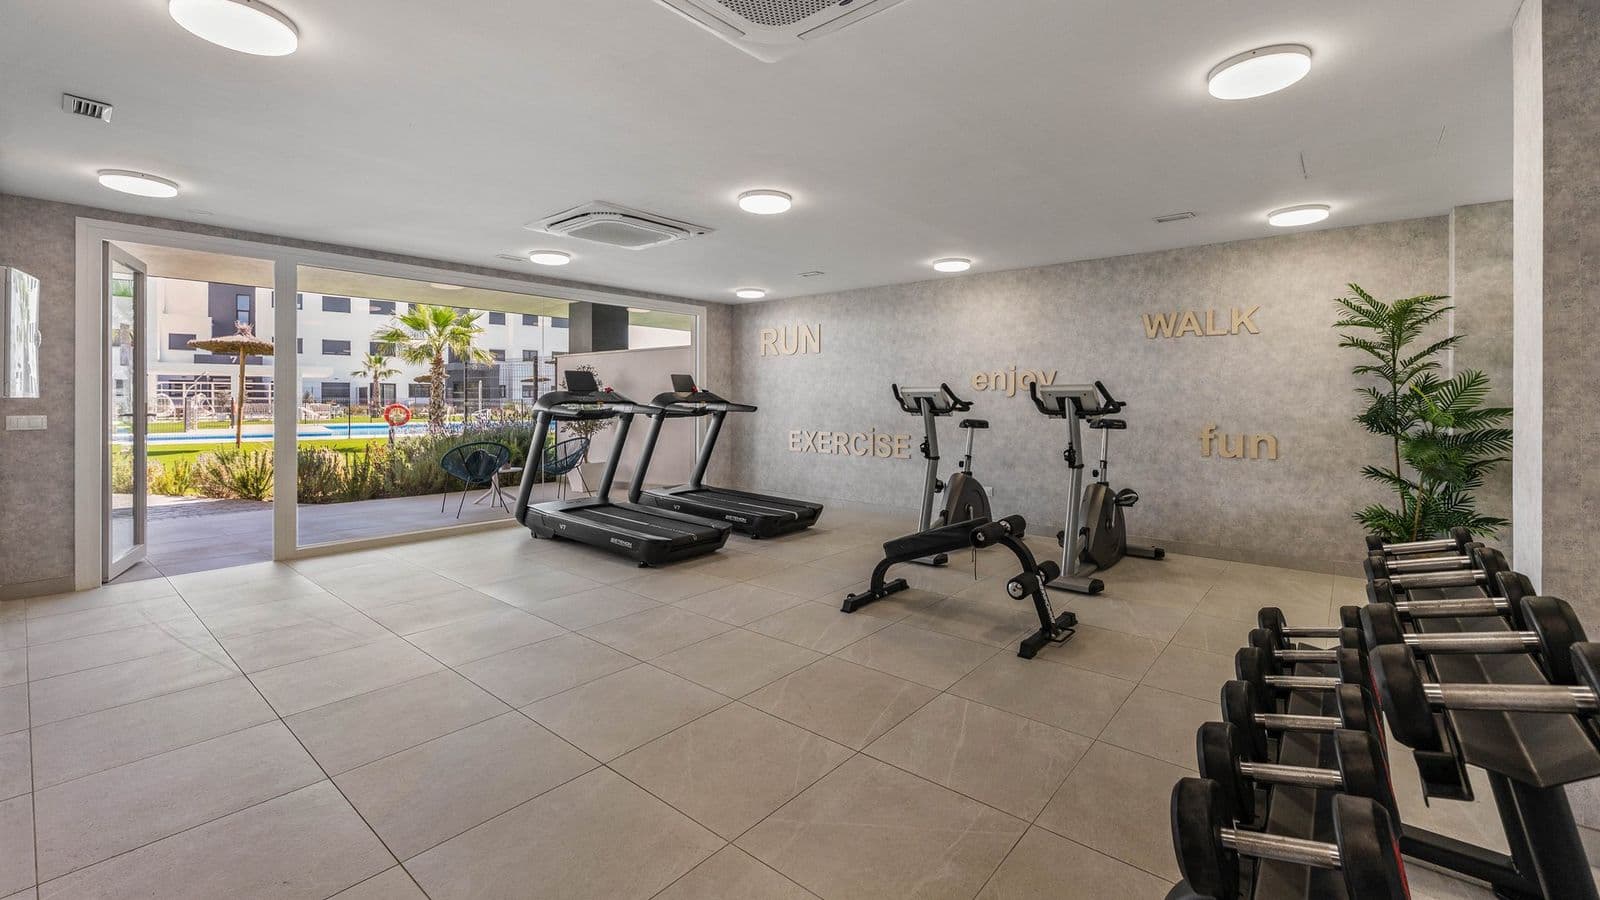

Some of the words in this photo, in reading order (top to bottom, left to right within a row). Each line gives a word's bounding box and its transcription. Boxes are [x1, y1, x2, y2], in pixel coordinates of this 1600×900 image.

[1141, 304, 1261, 339] WALK
[760, 322, 822, 357] RUN
[230, 355, 238, 363] 7
[1200, 422, 1278, 460] fun
